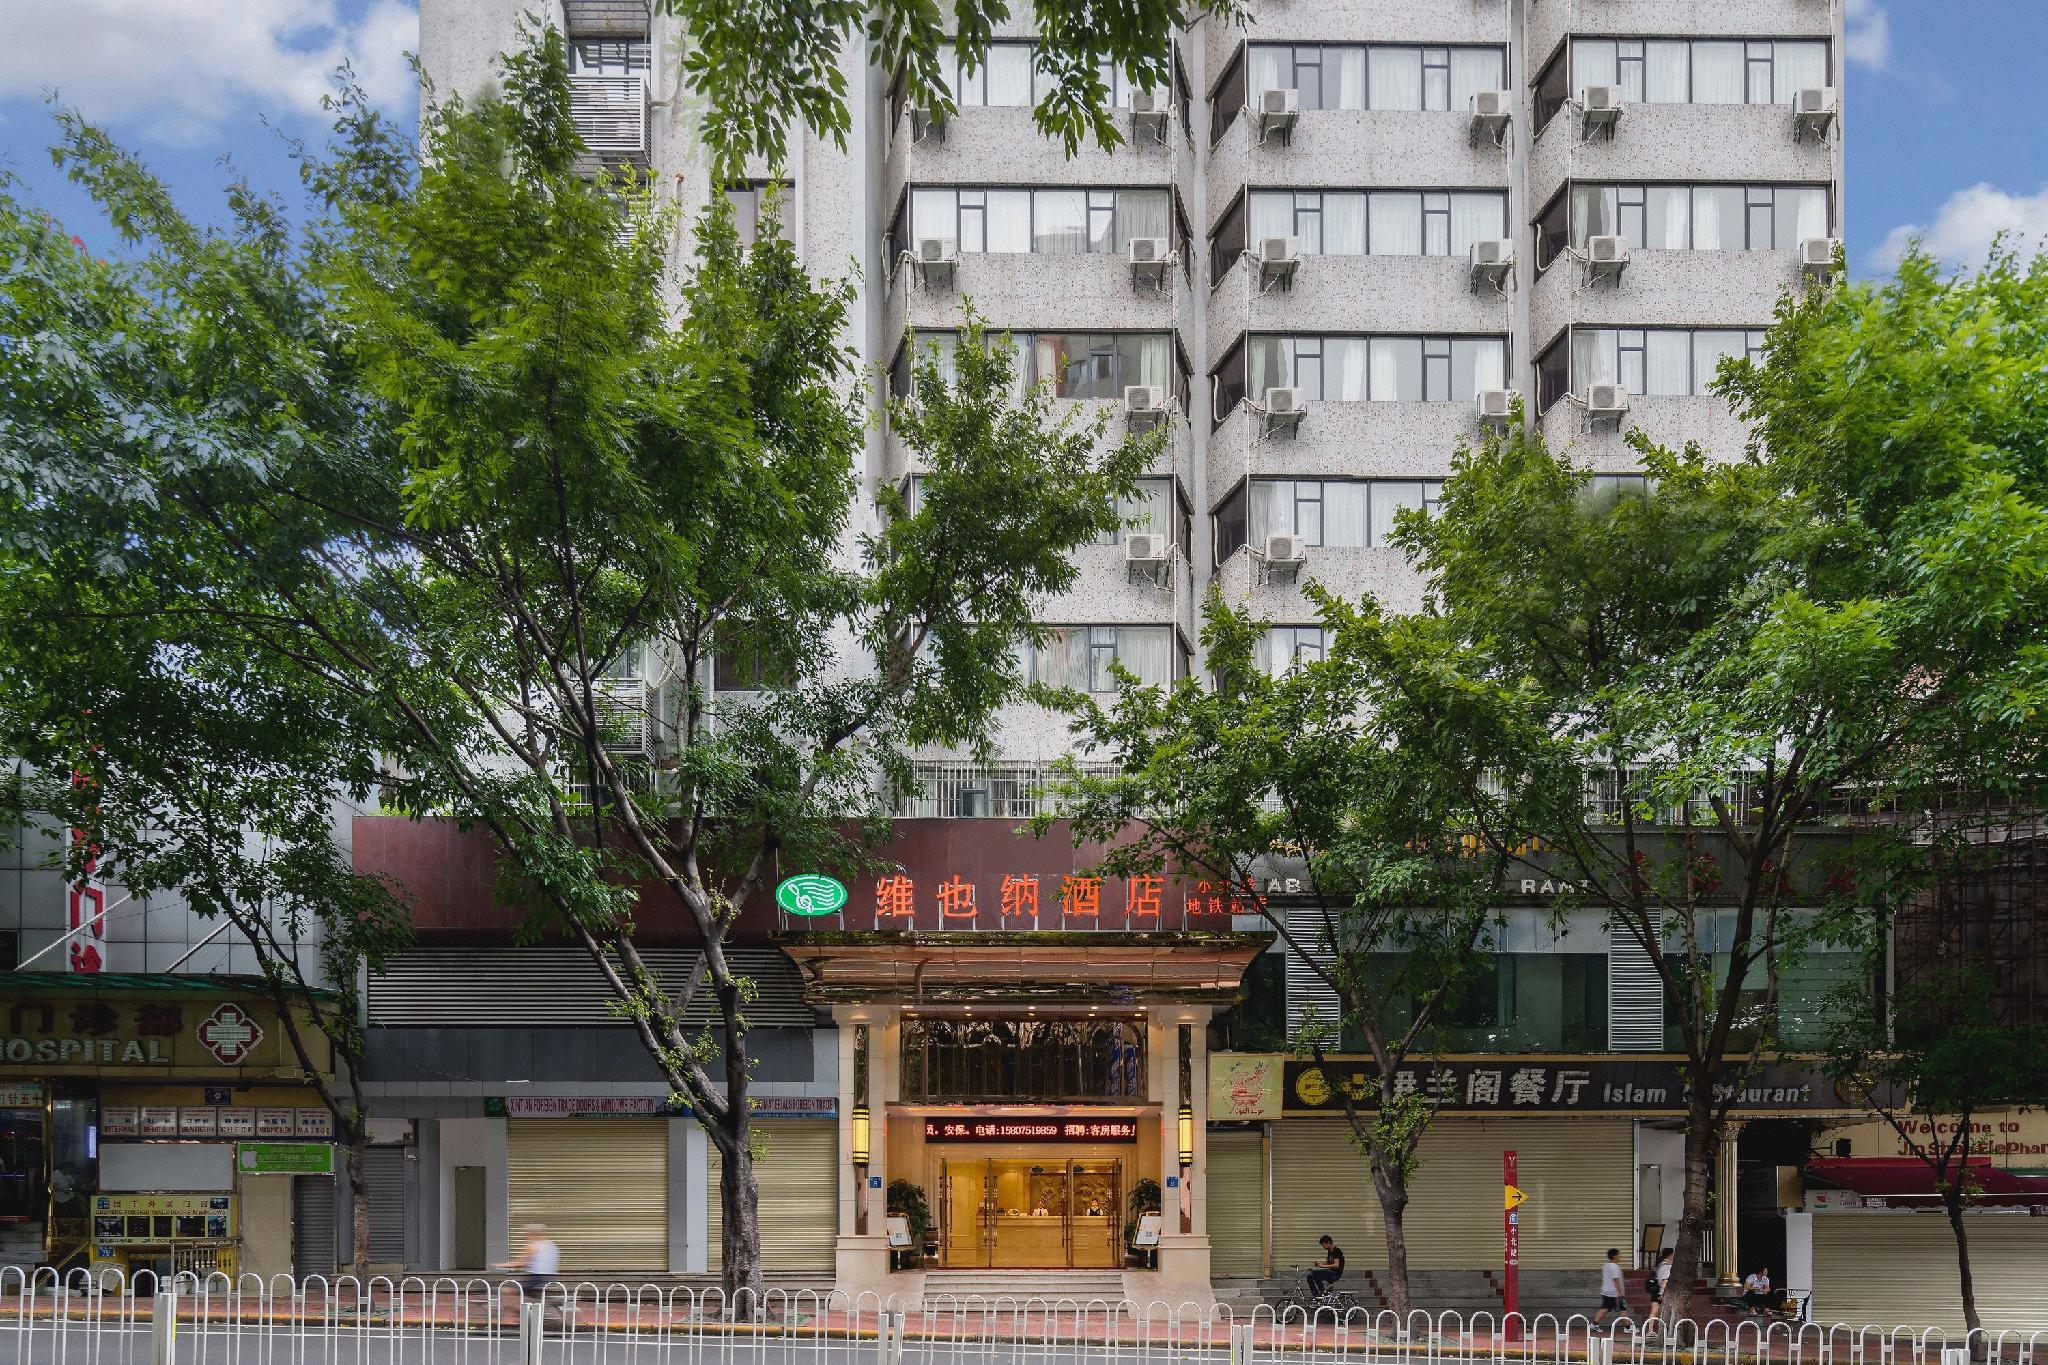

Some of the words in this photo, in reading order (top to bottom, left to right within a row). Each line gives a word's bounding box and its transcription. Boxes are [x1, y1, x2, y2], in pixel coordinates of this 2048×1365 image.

[876, 874, 1165, 918] 维也纳酒店
[0, 1038, 169, 1063] OSPITAL
[1603, 1082, 1667, 1104] Islam
[1898, 1118, 1992, 1135] Wecome
[1998, 1120, 2020, 1134] to
